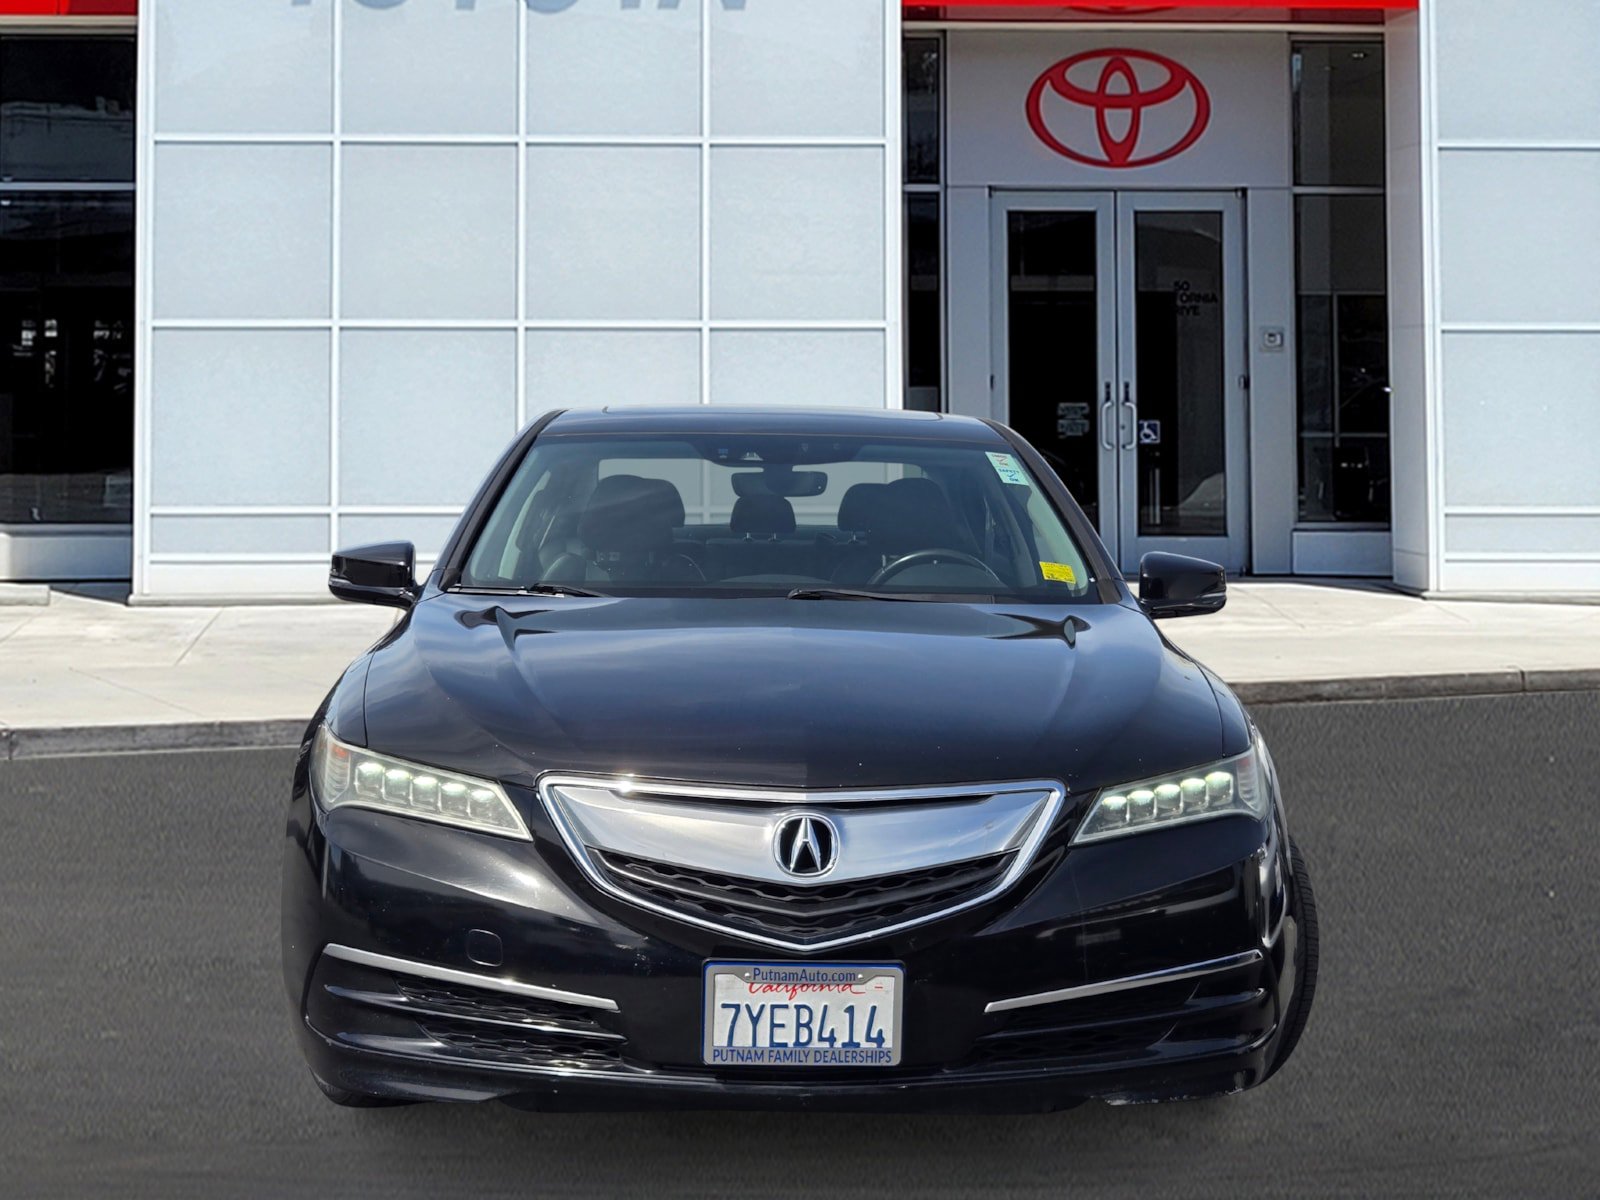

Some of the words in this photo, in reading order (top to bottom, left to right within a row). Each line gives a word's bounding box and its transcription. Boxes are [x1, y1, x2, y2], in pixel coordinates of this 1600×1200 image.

[753, 967, 856, 982] PutnamAuto.com
[721, 1003, 886, 1048] 7YEB414
[713, 1049, 764, 1062] PUTNAM
[768, 1050, 810, 1063] FAMILY
[814, 1050, 892, 1063] DEALERSHIPS
